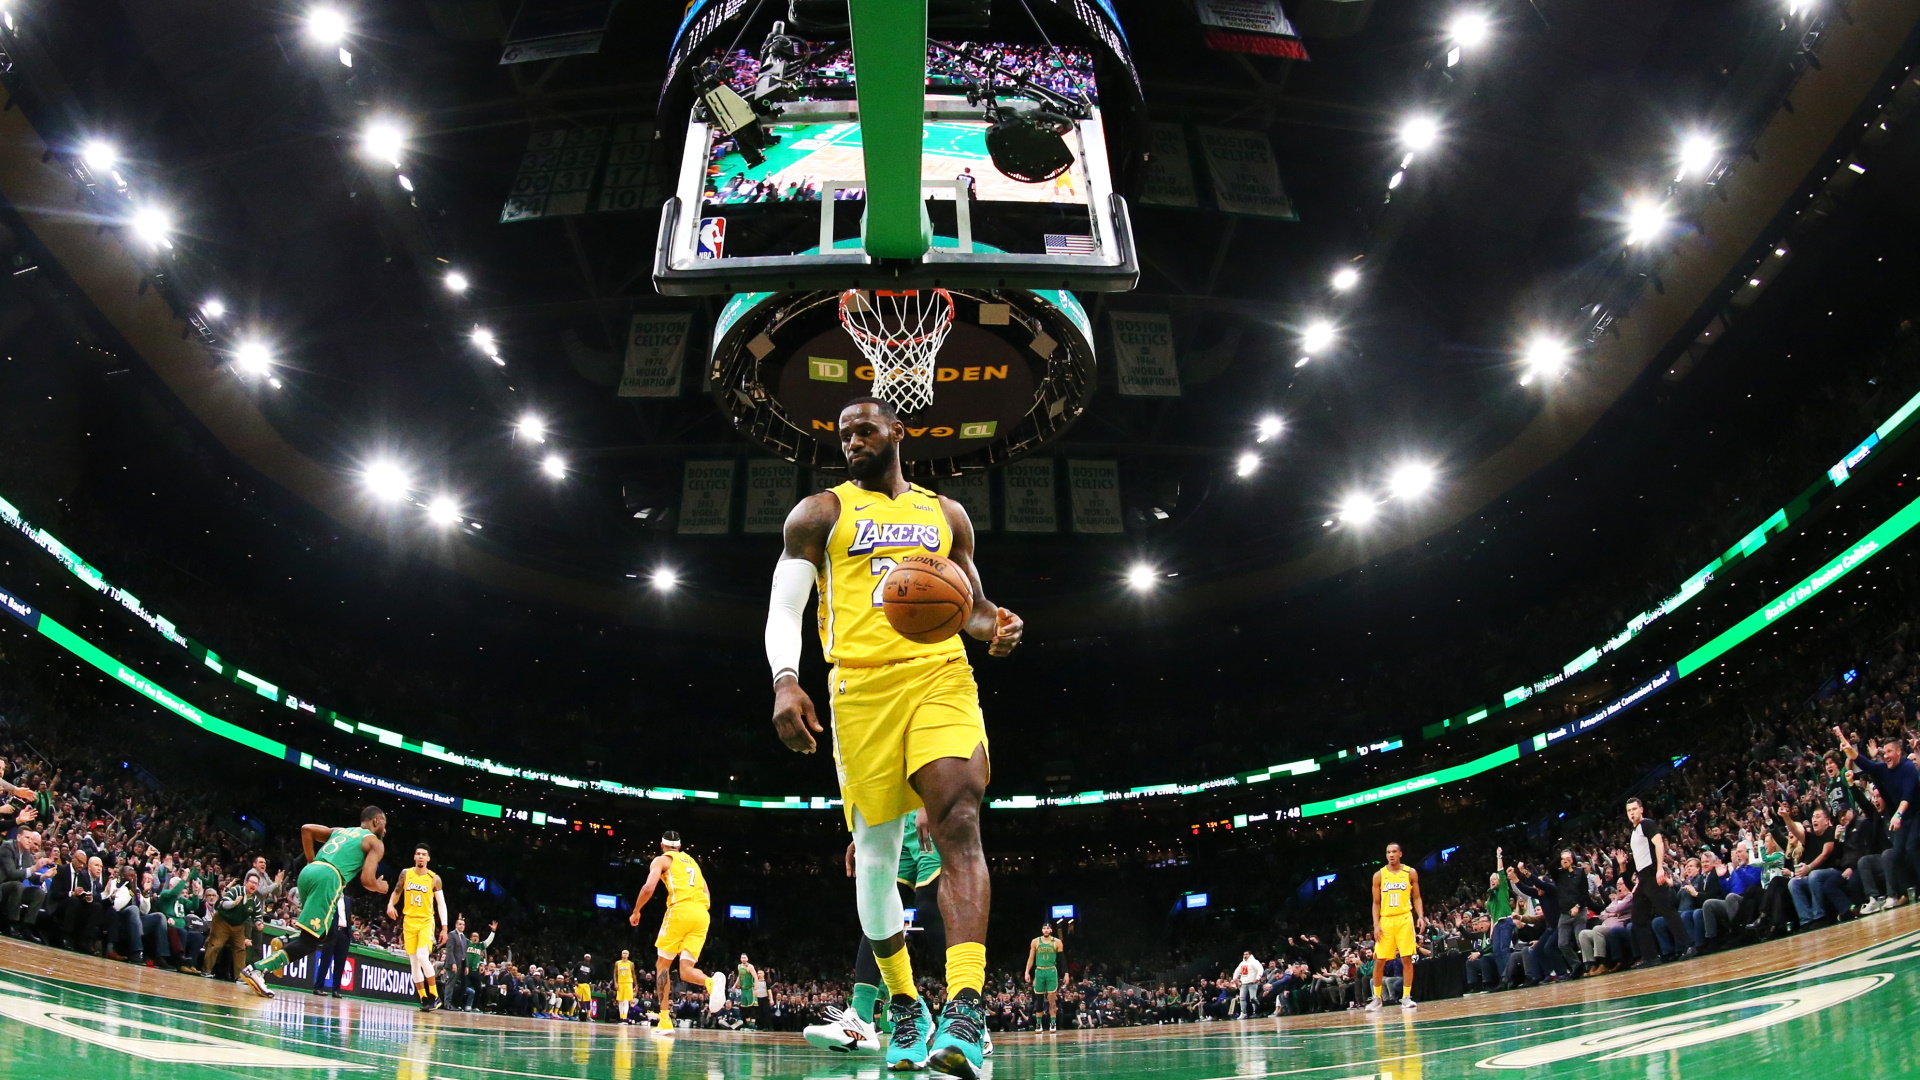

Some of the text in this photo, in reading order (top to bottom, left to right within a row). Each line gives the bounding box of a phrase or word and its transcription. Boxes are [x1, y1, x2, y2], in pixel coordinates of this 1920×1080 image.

[1206, 135, 1266, 150] BOSTON
[562, 150, 596, 167] 35
[618, 144, 646, 161] 19
[1213, 148, 1268, 164] CELTICS
[516, 173, 550, 192] 00
[559, 171, 590, 189] 31
[610, 167, 642, 184] 17
[605, 190, 637, 208] 10
[635, 322, 686, 333] BOSTON
[1116, 320, 1168, 332] BOSTON
[634, 335, 682, 346] CELTICS
[1121, 333, 1167, 345] CELTICS
[636, 367, 668, 377] WORLD
[812, 361, 844, 378] TD
[1131, 366, 1164, 376] WORLD
[688, 468, 730, 478] BOSTON
[751, 467, 795, 477] BOSTON
[1007, 466, 1049, 476] BOSTON
[1073, 467, 1114, 478] BOSTON
[689, 480, 727, 490] CELTICS
[752, 478, 792, 488] CELTICS
[1010, 477, 1049, 488] CELTICS
[1075, 479, 1114, 489] CELTICS
[692, 509, 719, 517] WORLD
[757, 508, 784, 516] WORLD
[912, 503, 933, 512] wish
[1018, 507, 1045, 515] WORLD
[1084, 508, 1110, 516] WORLD
[848, 519, 940, 557] LAKERS
[1764, 600, 1787, 621] Bank
[1796, 585, 1811, 601] the
[1810, 562, 1844, 591] Boston
[118, 667, 136, 685] Bank
[1547, 727, 1567, 741] Bank
[1580, 710, 1607, 729] America's
[1607, 702, 1621, 716] Most
[1621, 683, 1652, 707] Convenient
[313, 759, 330, 772] Bank
[343, 770, 375, 785] America's
[377, 778, 394, 790] Most
[396, 784, 433, 800] Convenient
[1047, 795, 1072, 806] fraud
[1102, 791, 1122, 801] with
[1124, 790, 1140, 801] any
[1335, 798, 1354, 809] Bank
[1356, 794, 1364, 804] of
[1364, 792, 1377, 802] the
[505, 808, 528, 821] 7:48
[1275, 807, 1300, 821] 7:48
[322, 836, 347, 854] 8
[686, 867, 695, 887] 7
[1383, 882, 1407, 892] LAKERS
[410, 893, 422, 907] 14
[1389, 893, 1399, 907] 11
[361, 965, 415, 995] THURSDAYS
